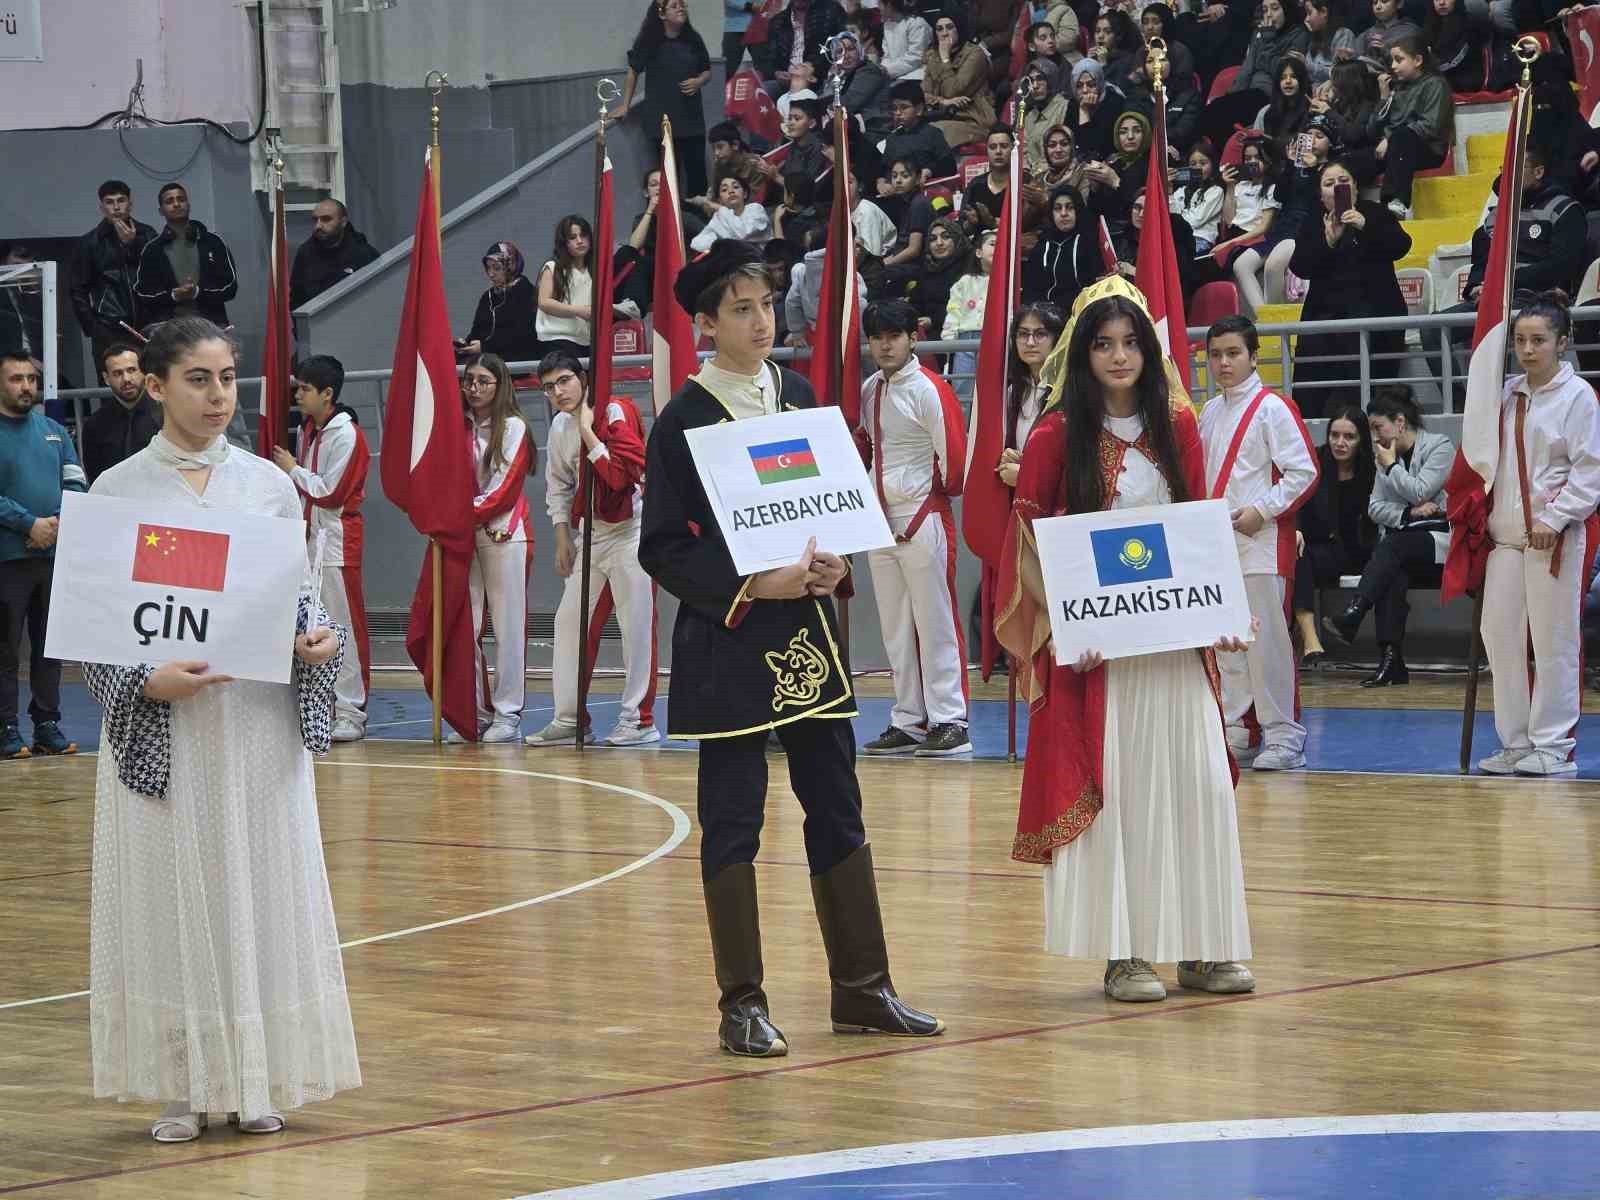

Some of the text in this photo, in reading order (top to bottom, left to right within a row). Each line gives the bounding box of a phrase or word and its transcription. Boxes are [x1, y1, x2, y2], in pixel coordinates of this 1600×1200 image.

[733, 489, 865, 531] AZERBAYCAN
[133, 595, 209, 646] ÇİN
[1062, 584, 1223, 622] KAZAKİSTAN
